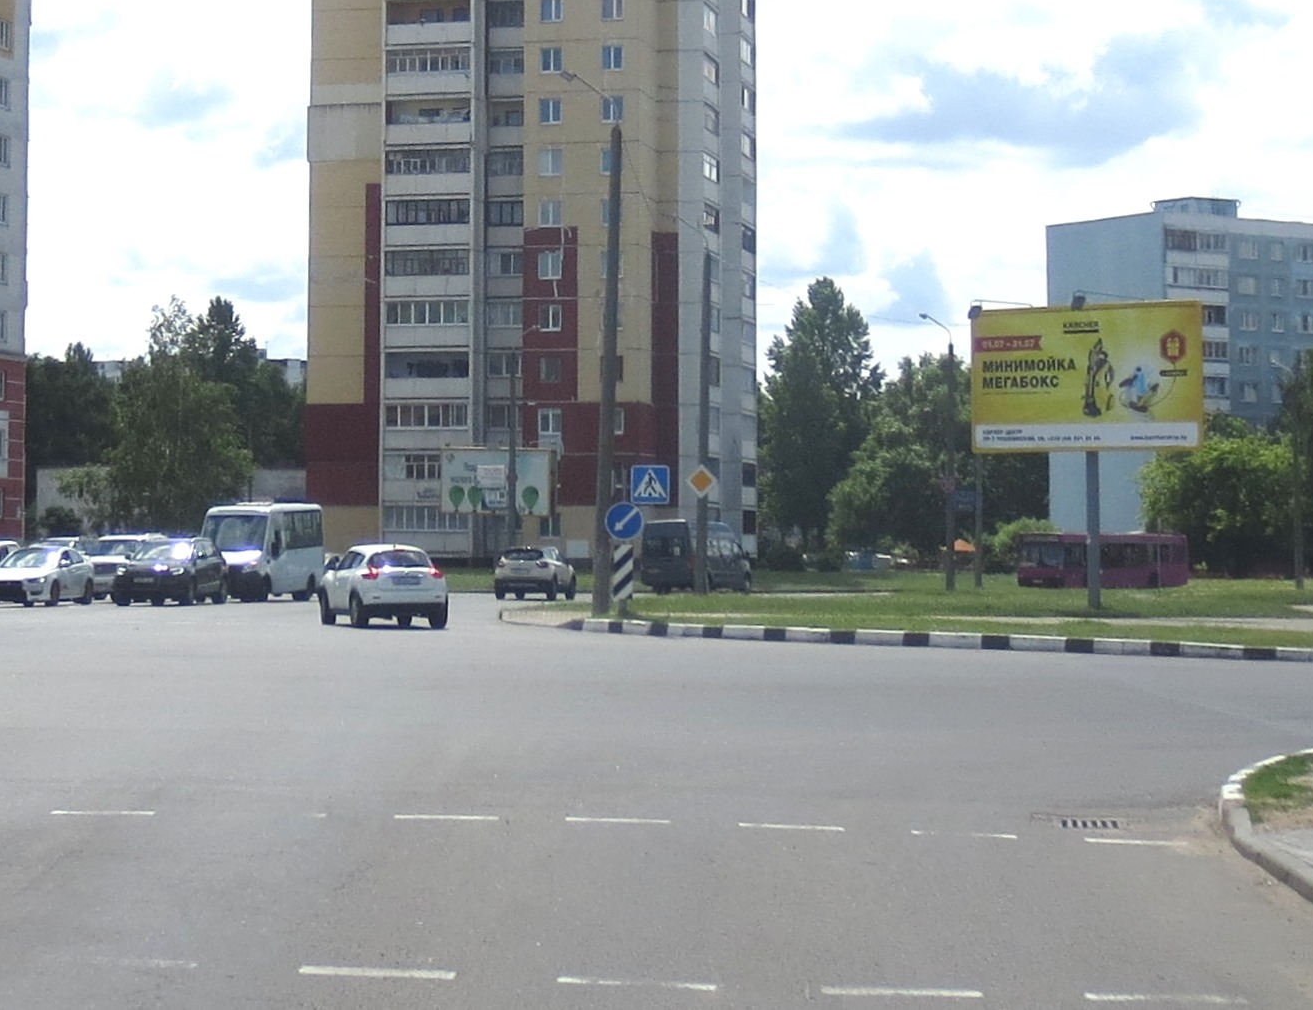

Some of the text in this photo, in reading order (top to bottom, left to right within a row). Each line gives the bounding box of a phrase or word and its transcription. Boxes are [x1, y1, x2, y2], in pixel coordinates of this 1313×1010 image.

[982, 339, 1004, 349] 01.07
[982, 356, 1077, 373] МИНИМОЙКА
[982, 375, 1060, 389] МЕГАБОКС
